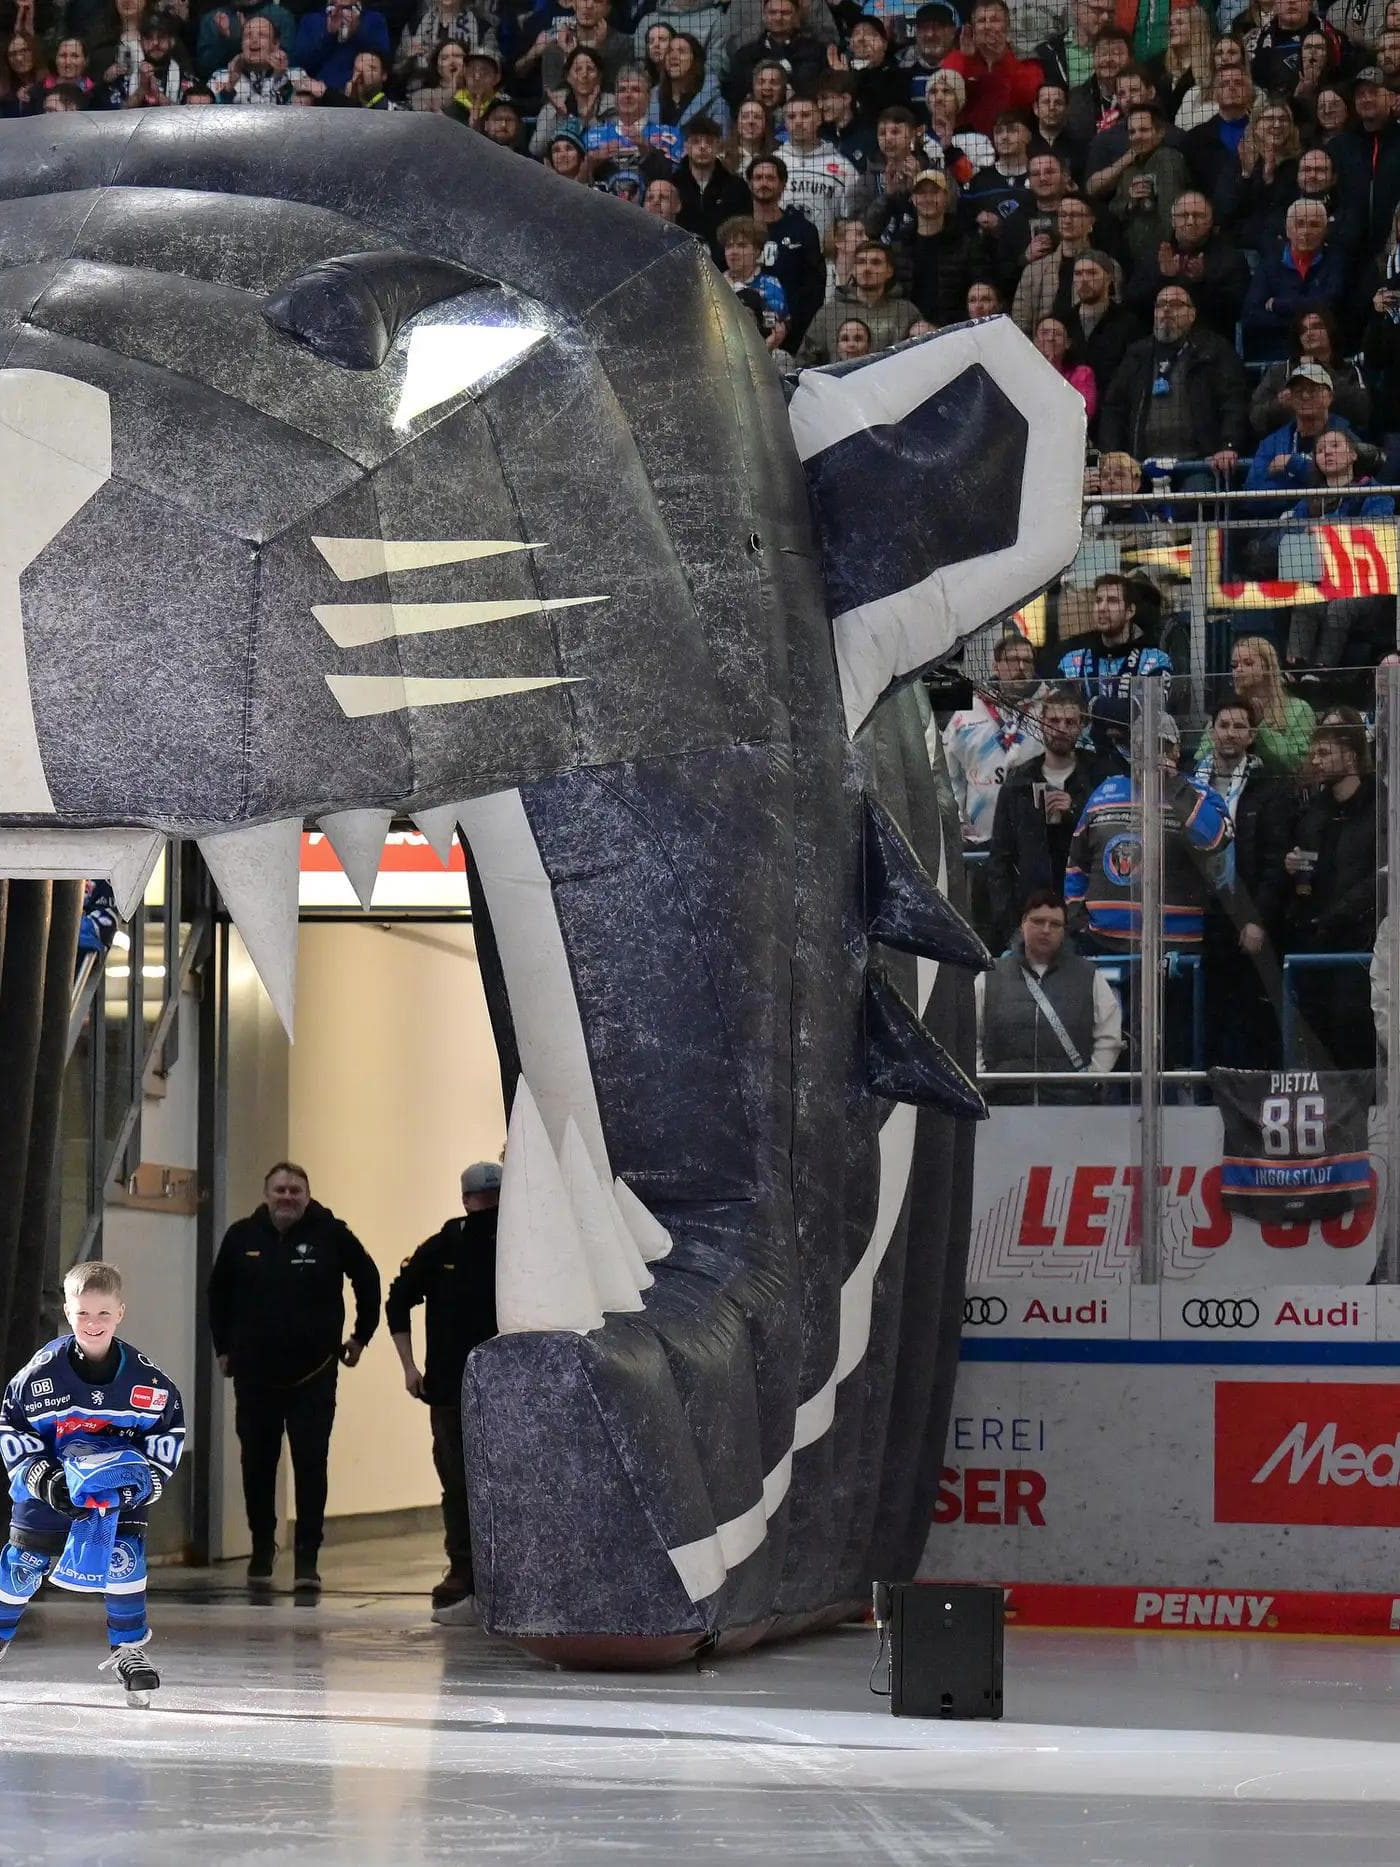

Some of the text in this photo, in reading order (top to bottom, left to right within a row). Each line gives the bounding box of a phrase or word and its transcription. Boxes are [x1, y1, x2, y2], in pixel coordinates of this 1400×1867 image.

[791, 181, 835, 198] SATURN
[1271, 1072, 1319, 1093] PIETTA
[1261, 1096, 1327, 1156] 86
[1255, 1166, 1333, 1187] INGOLSTADT
[1022, 1299, 1108, 1324] Audi
[1274, 1301, 1359, 1326] Audi
[33, 1381, 51, 1394] DB
[24, 1400, 43, 1413] egio
[954, 1417, 1045, 1451] EREI
[146, 1434, 185, 1463] 10
[1252, 1421, 1400, 1487] Med
[933, 1466, 1047, 1527] SER
[20, 1551, 44, 1567] ERC
[55, 1564, 104, 1582] OLSTADT
